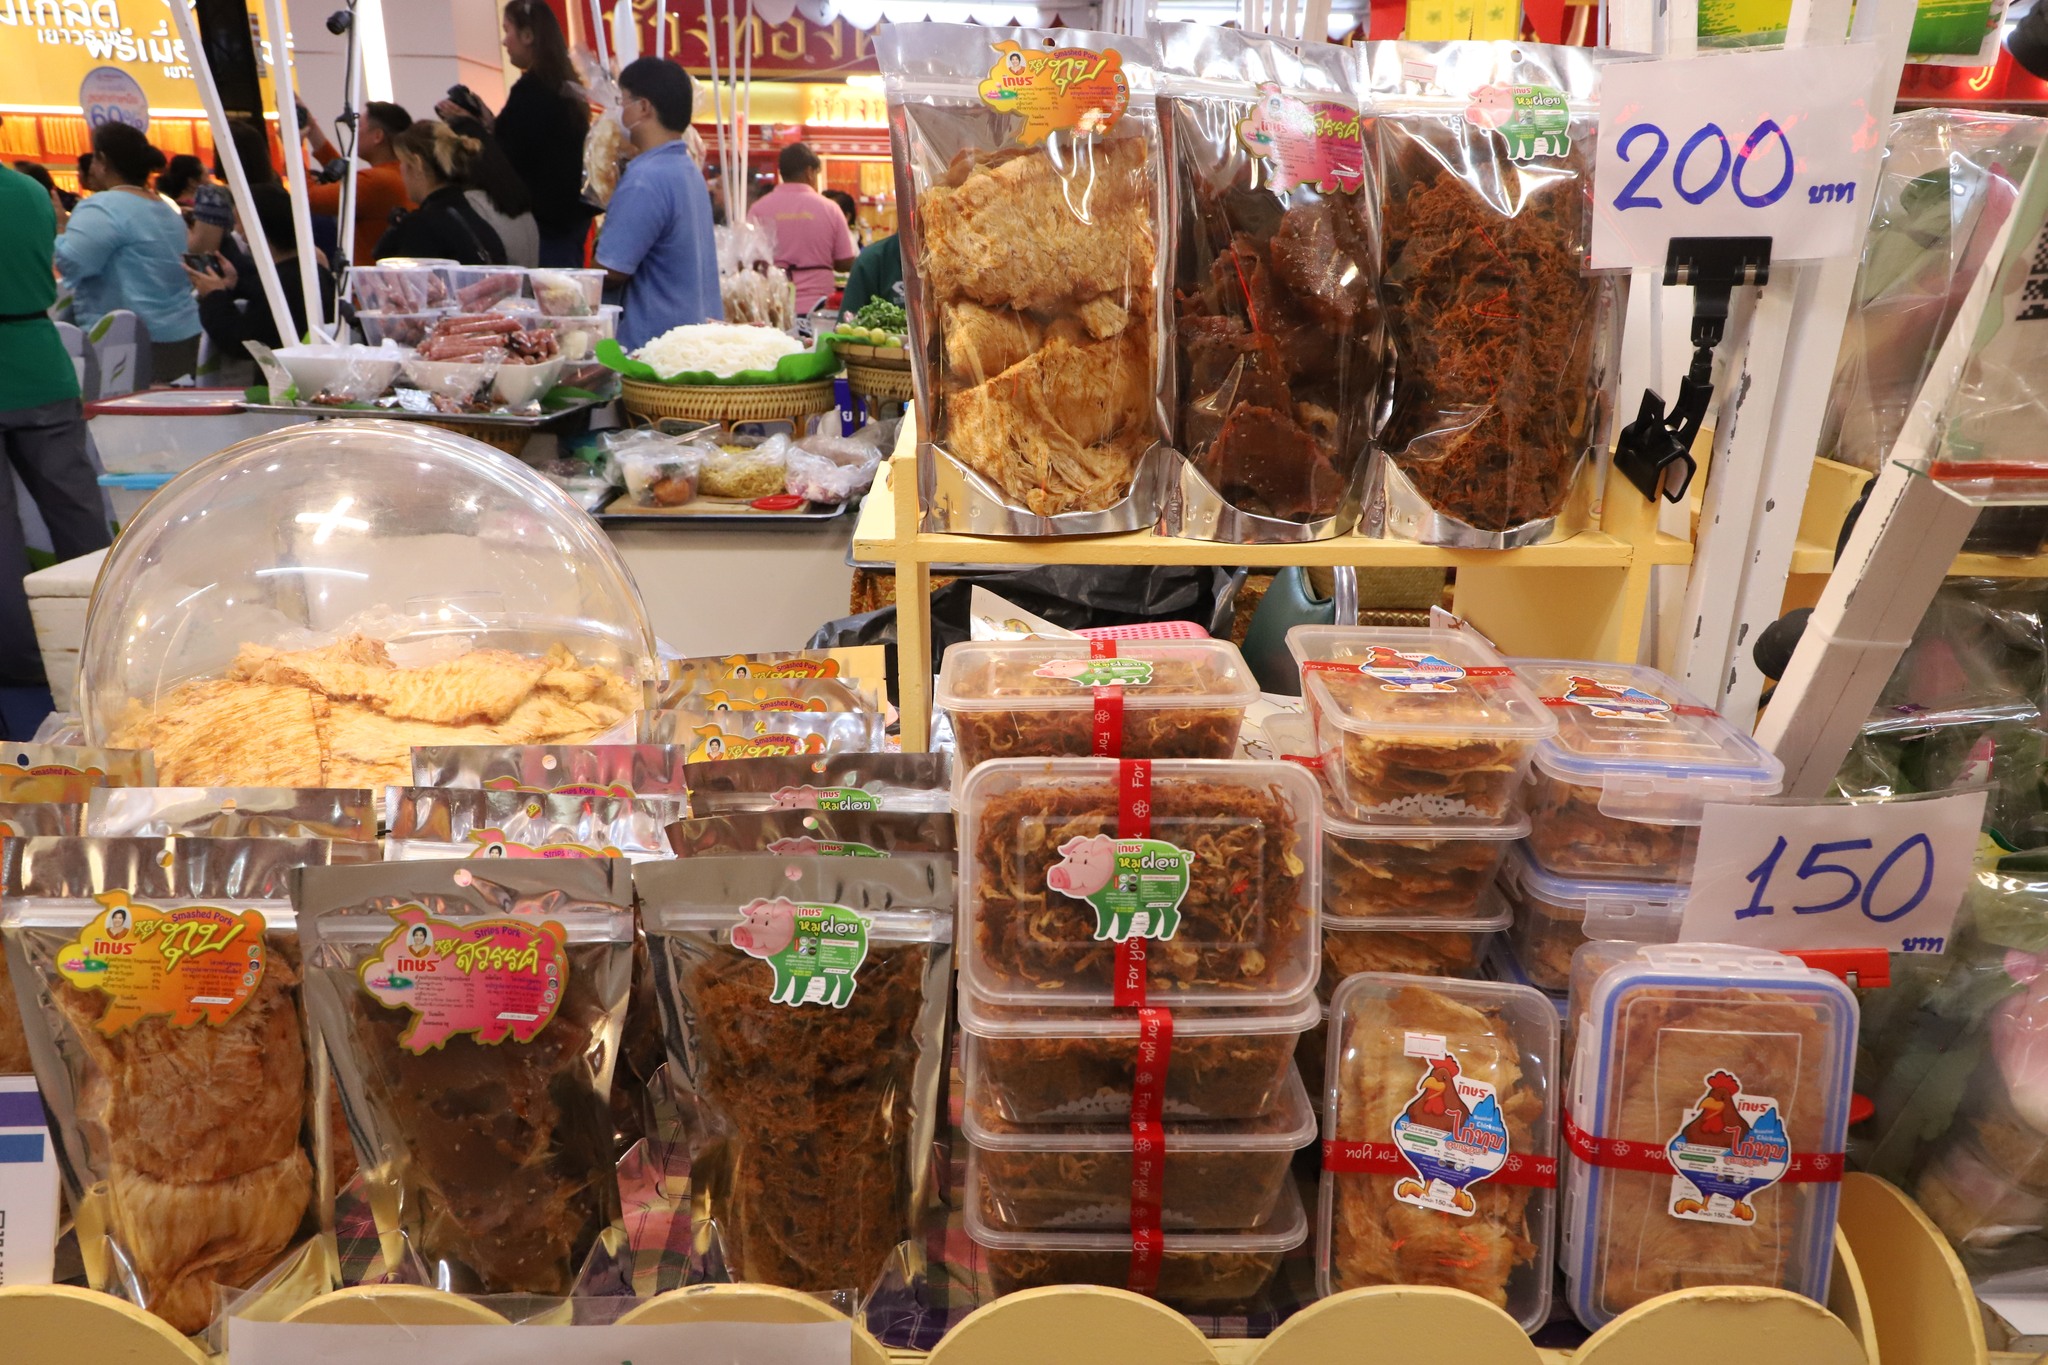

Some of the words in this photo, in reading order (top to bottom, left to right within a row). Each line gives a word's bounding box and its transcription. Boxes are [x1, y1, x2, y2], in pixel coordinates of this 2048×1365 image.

[1053, 49, 1082, 59] Smashed
[1083, 50, 1099, 61] Pork
[1515, 92, 1561, 109] หมูฝอย
[1613, 119, 1794, 212] 200
[1808, 181, 1856, 204] บาท
[777, 661, 804, 672] Smashed
[804, 661, 818, 671] Pork
[760, 700, 788, 711] Smashed
[789, 700, 805, 710] Pork
[754, 735, 785, 746] Smashed
[1099, 732, 1110, 750] For
[1132, 763, 1145, 788] For
[579, 786, 596, 795] Pork
[821, 796, 871, 811] หมฝอย
[543, 850, 565, 858] Strips
[1119, 851, 1179, 873] หมูฝอย
[1735, 833, 1935, 922] 150
[1902, 937, 1945, 953] บาท
[172, 909, 212, 923] Smashed
[213, 911, 234, 926] Pork
[799, 915, 859, 937] หมูฝอย
[474, 926, 500, 940] Strips
[501, 925, 522, 938] Pork
[1126, 965, 1140, 989] For
[1147, 1019, 1161, 1039] For
[1140, 1042, 1157, 1063] you
[1444, 1108, 1505, 1155] ไก่ทุบ
[1345, 1143, 1373, 1159] you
[1578, 1138, 1599, 1154] For
[1723, 1125, 1787, 1167] ไก่ทุบ
[1376, 1149, 1399, 1162] For
[1140, 1160, 1152, 1177] For
[1132, 1179, 1149, 1199] you
